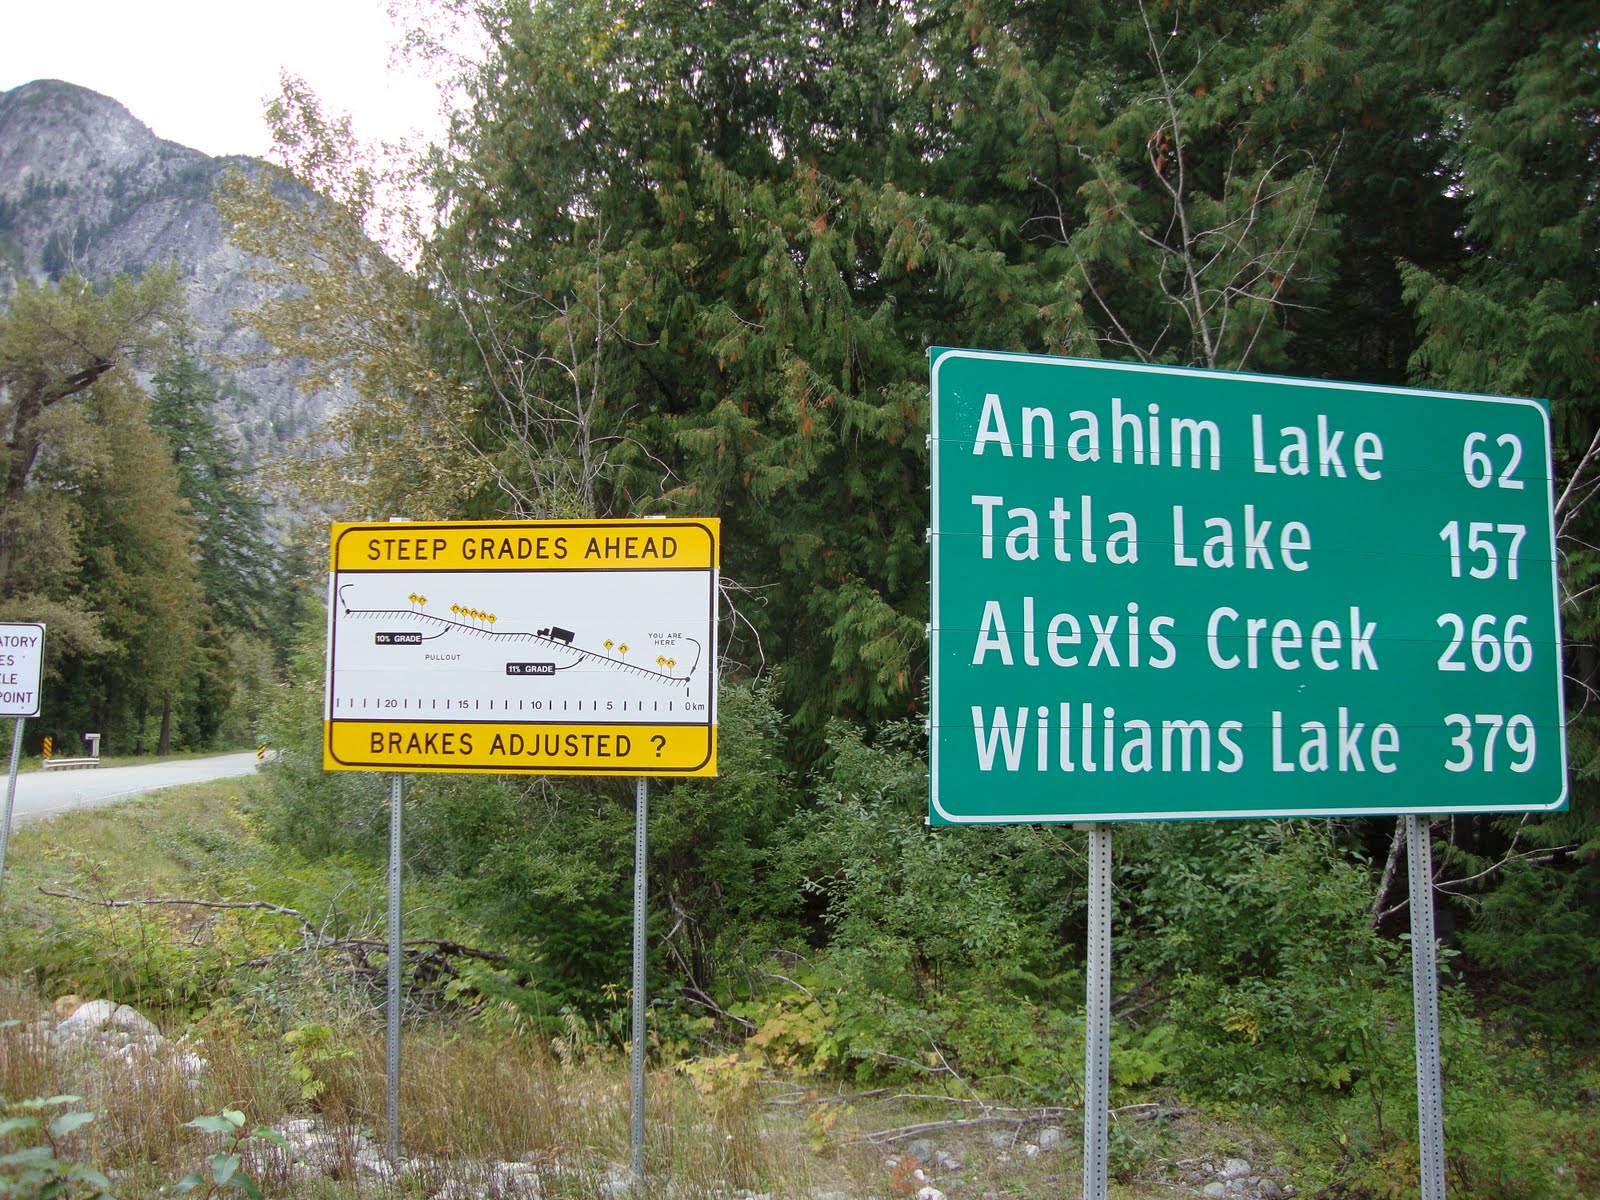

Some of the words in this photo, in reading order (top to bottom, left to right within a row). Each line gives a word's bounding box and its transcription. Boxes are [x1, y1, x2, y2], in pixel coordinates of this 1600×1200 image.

[973, 394, 1220, 471] Anahim
[1253, 414, 1384, 481] Lake
[1463, 432, 1525, 491] 62
[368, 538, 447, 561] STEEP
[462, 537, 569, 560] GRADES
[584, 536, 678, 559] AHEAD
[971, 495, 1139, 564] Tatla
[1174, 504, 1312, 572] Lake
[1439, 520, 1526, 580] 157
[376, 635, 391, 643] 10%
[394, 635, 421, 643] GRADE
[972, 597, 1177, 671] Alexis
[1208, 606, 1379, 671] Creek
[1437, 613, 1533, 673] 266
[0, 673, 18, 685] LE
[385, 700, 398, 708] 20
[458, 700, 469, 709] 15
[531, 701, 542, 709] 10
[606, 701, 613, 710] 5
[370, 732, 473, 755] BRAKES
[489, 734, 631, 757] ADJUSTED
[650, 735, 667, 758] ?
[971, 702, 1244, 774] Williams
[1272, 707, 1399, 774] Lake
[1444, 713, 1536, 774] 379
